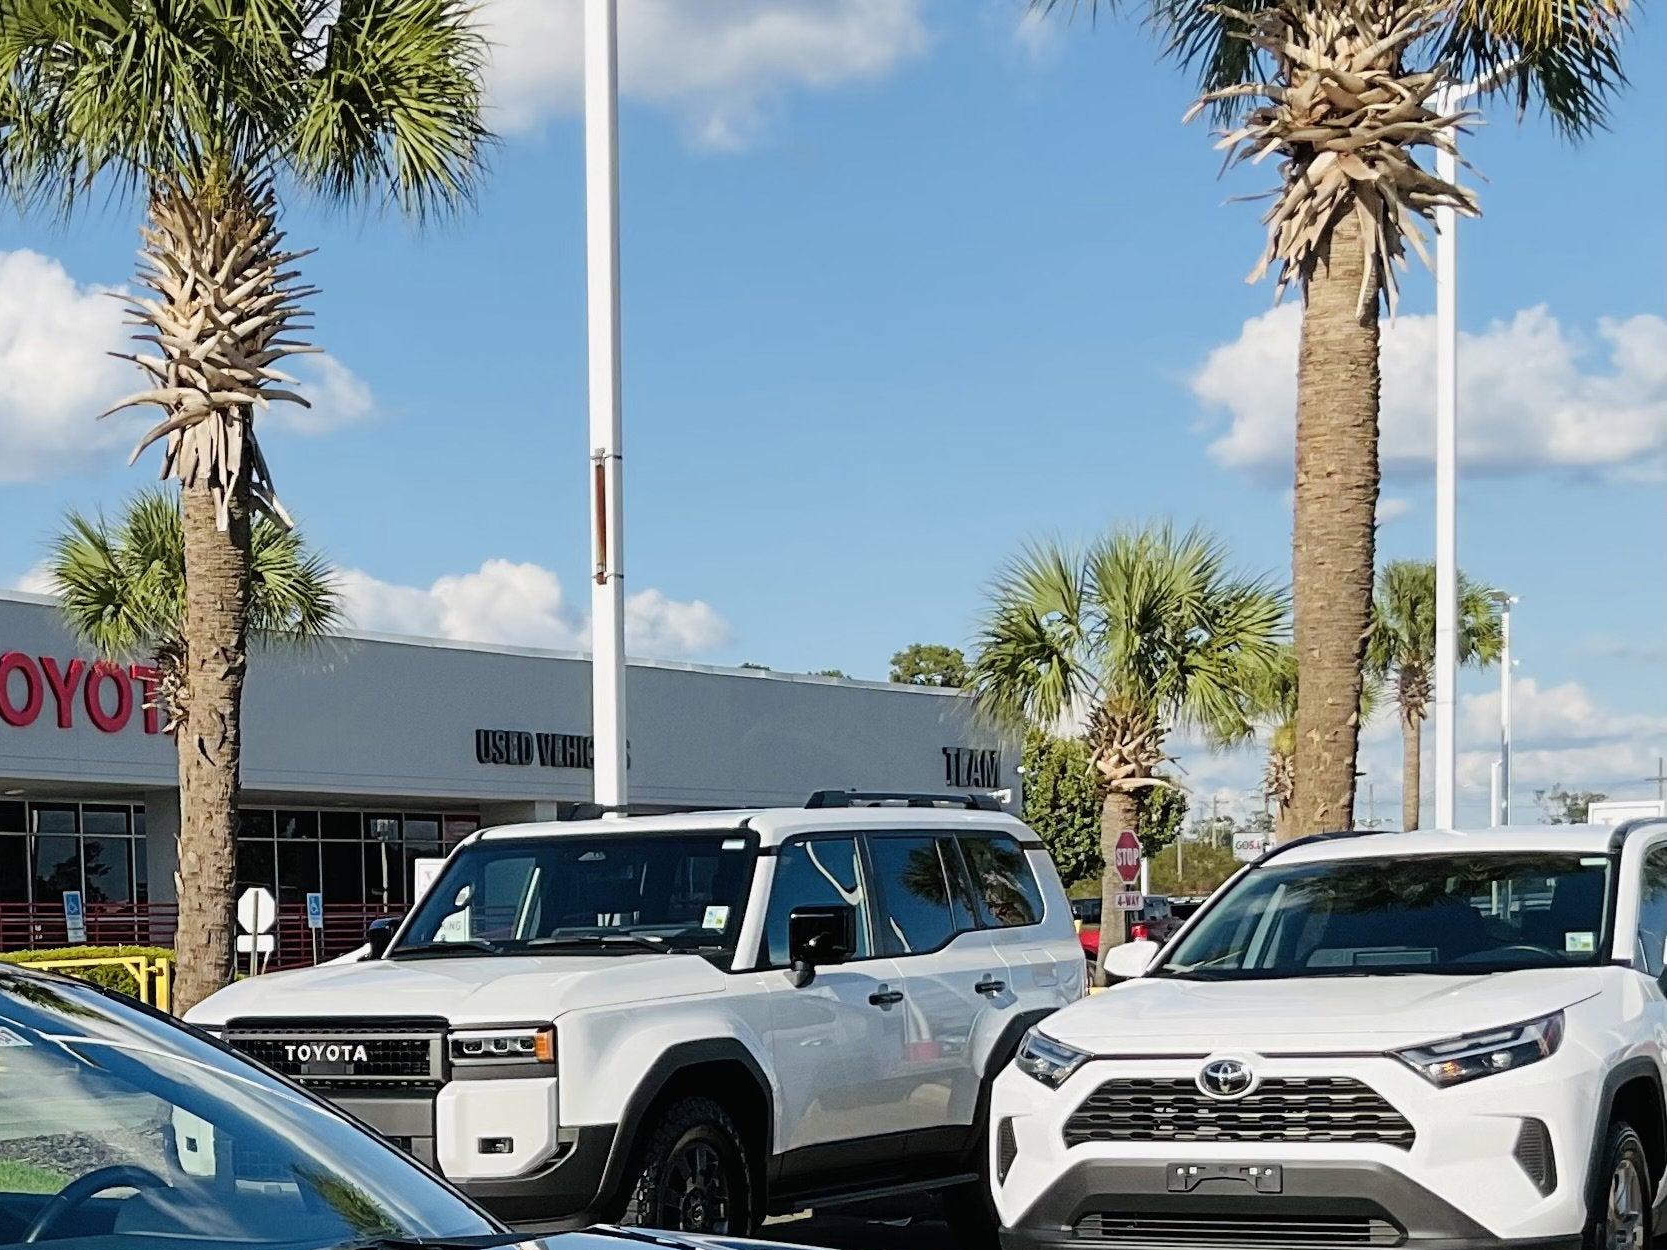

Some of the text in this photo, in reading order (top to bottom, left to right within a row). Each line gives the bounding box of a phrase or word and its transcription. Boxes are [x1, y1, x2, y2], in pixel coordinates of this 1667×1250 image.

[475, 729, 534, 765] USED
[1116, 848, 1139, 866] STOP
[1117, 896, 1139, 906] 4-WAY
[285, 1045, 367, 1062] TOYOTA
